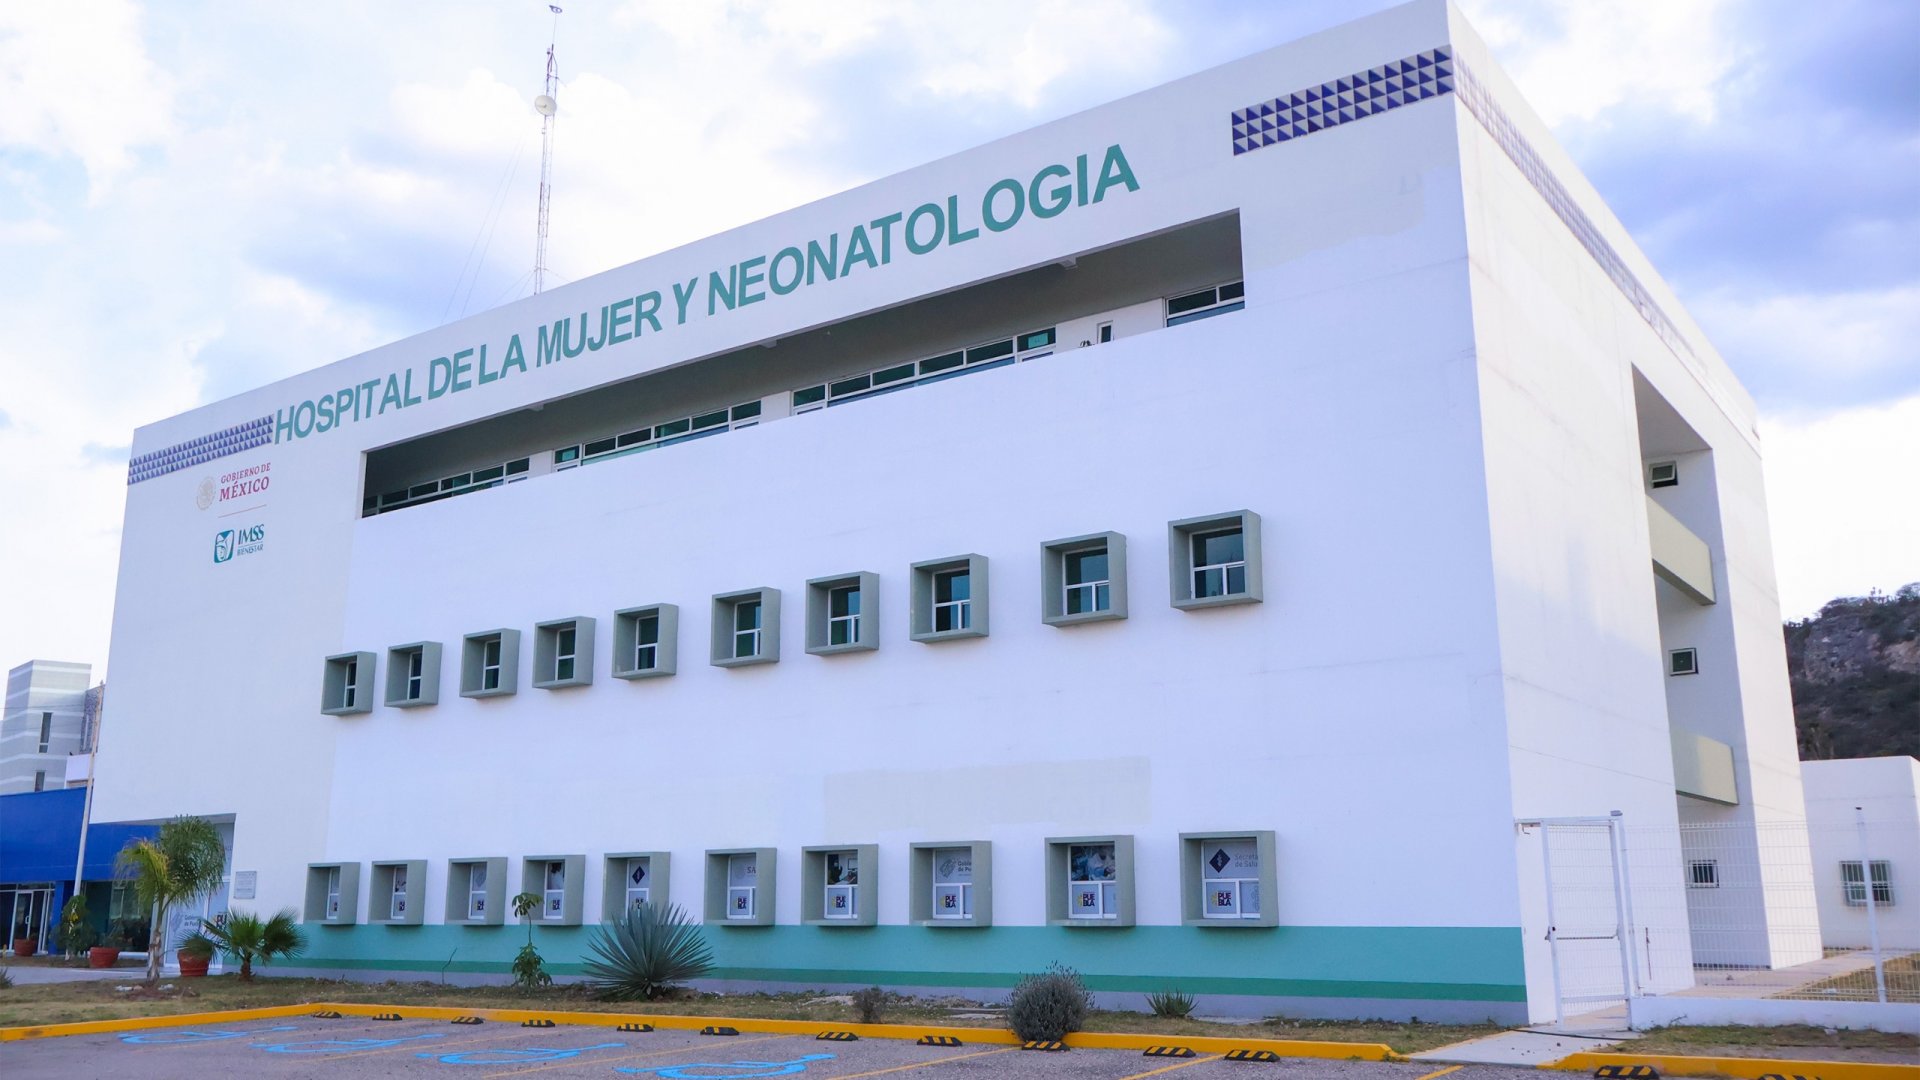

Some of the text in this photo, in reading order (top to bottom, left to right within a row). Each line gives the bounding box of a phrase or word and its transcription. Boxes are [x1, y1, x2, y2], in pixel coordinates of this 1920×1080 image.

[274, 144, 1141, 445] HOSPITAL DE LA MUJER Y NEONATOLOGIA
[220, 462, 271, 484] GOBIERNO DE
[219, 476, 270, 502] MÉXICO
[238, 524, 265, 545] IMSS
[237, 544, 264, 556] BIENESTAR
